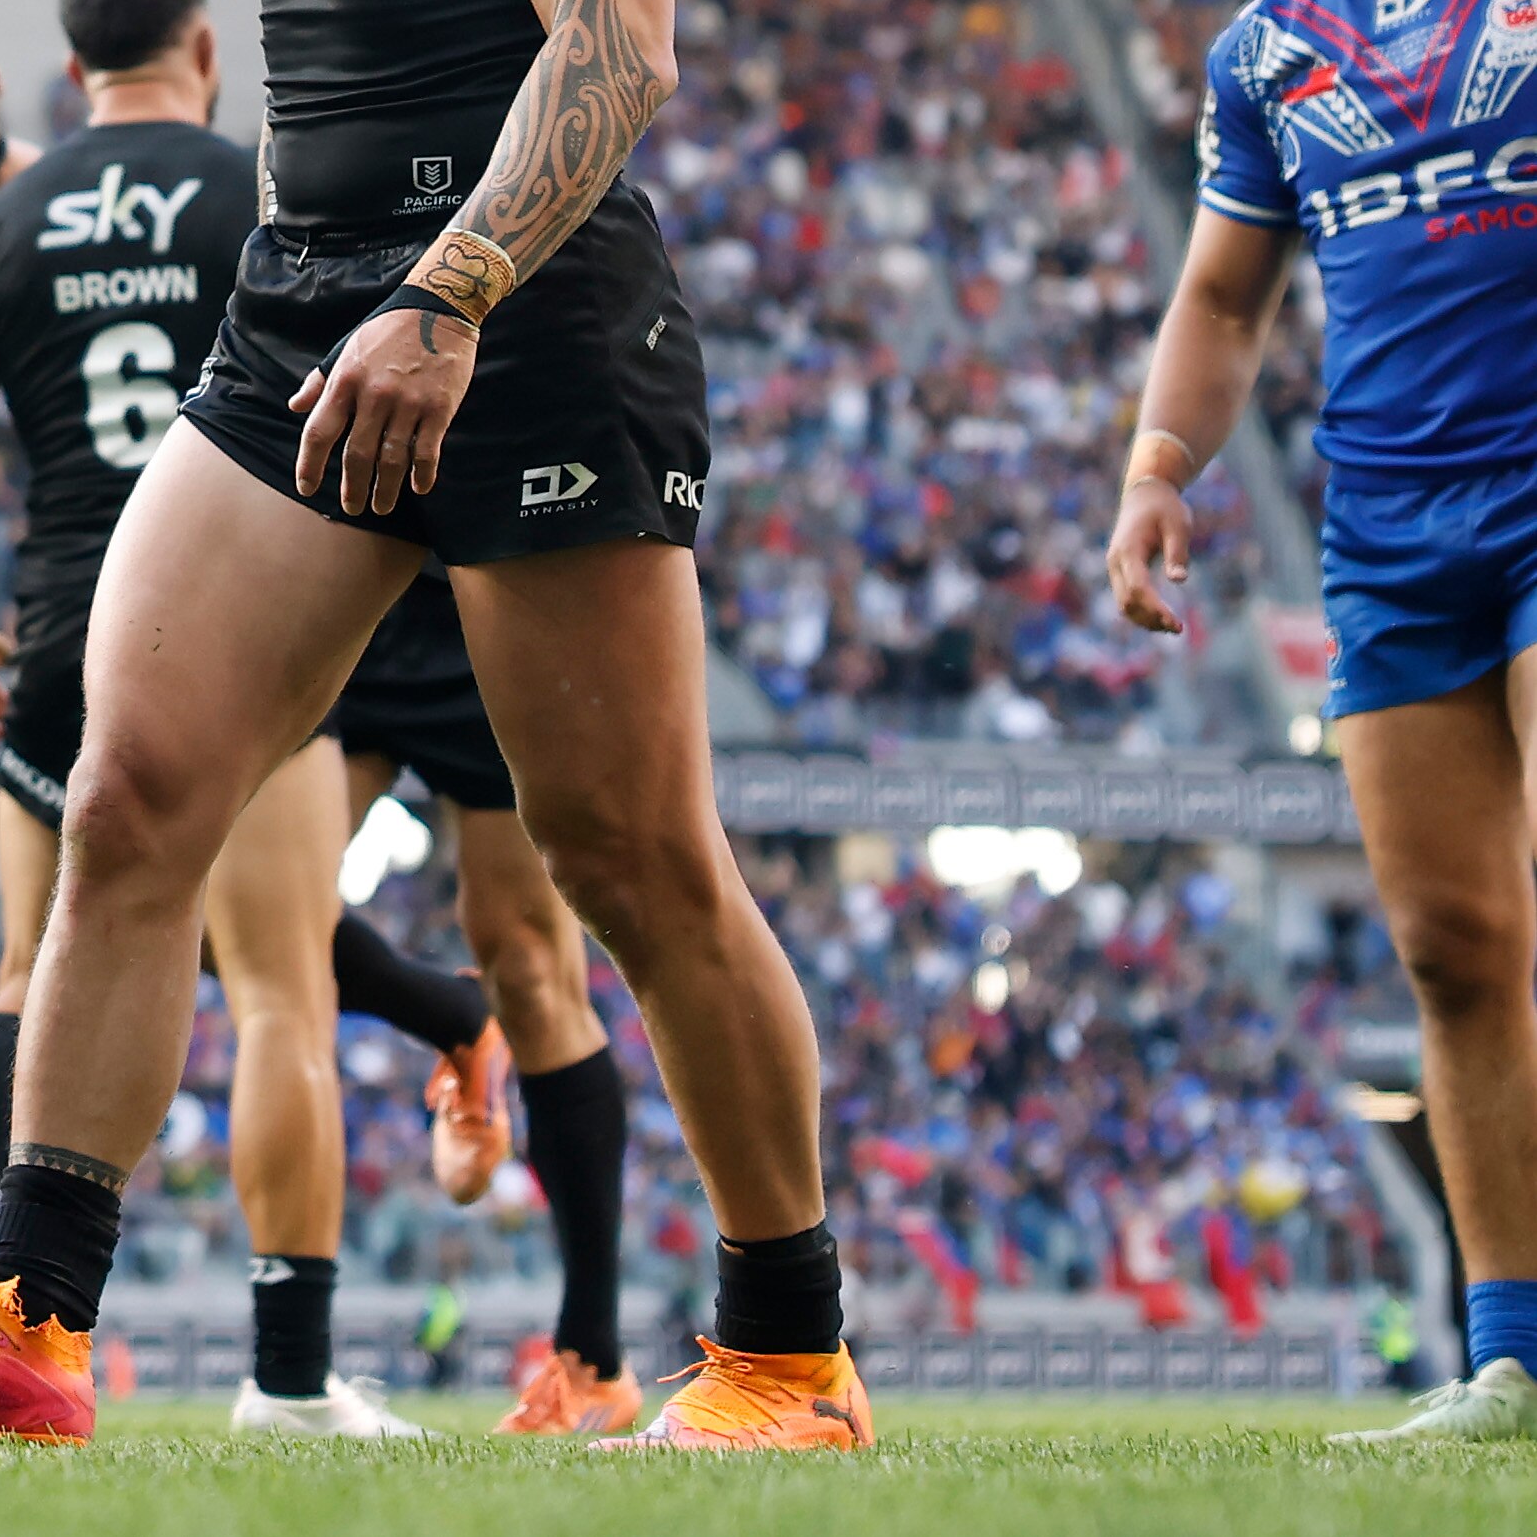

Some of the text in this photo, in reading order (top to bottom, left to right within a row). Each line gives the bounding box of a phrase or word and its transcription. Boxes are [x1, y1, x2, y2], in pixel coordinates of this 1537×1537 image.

[404, 194, 463, 208] PACIFIC
[55, 266, 199, 314] BROWN
[83, 321, 181, 470] 6
[519, 488, 600, 519] DYNASTY
